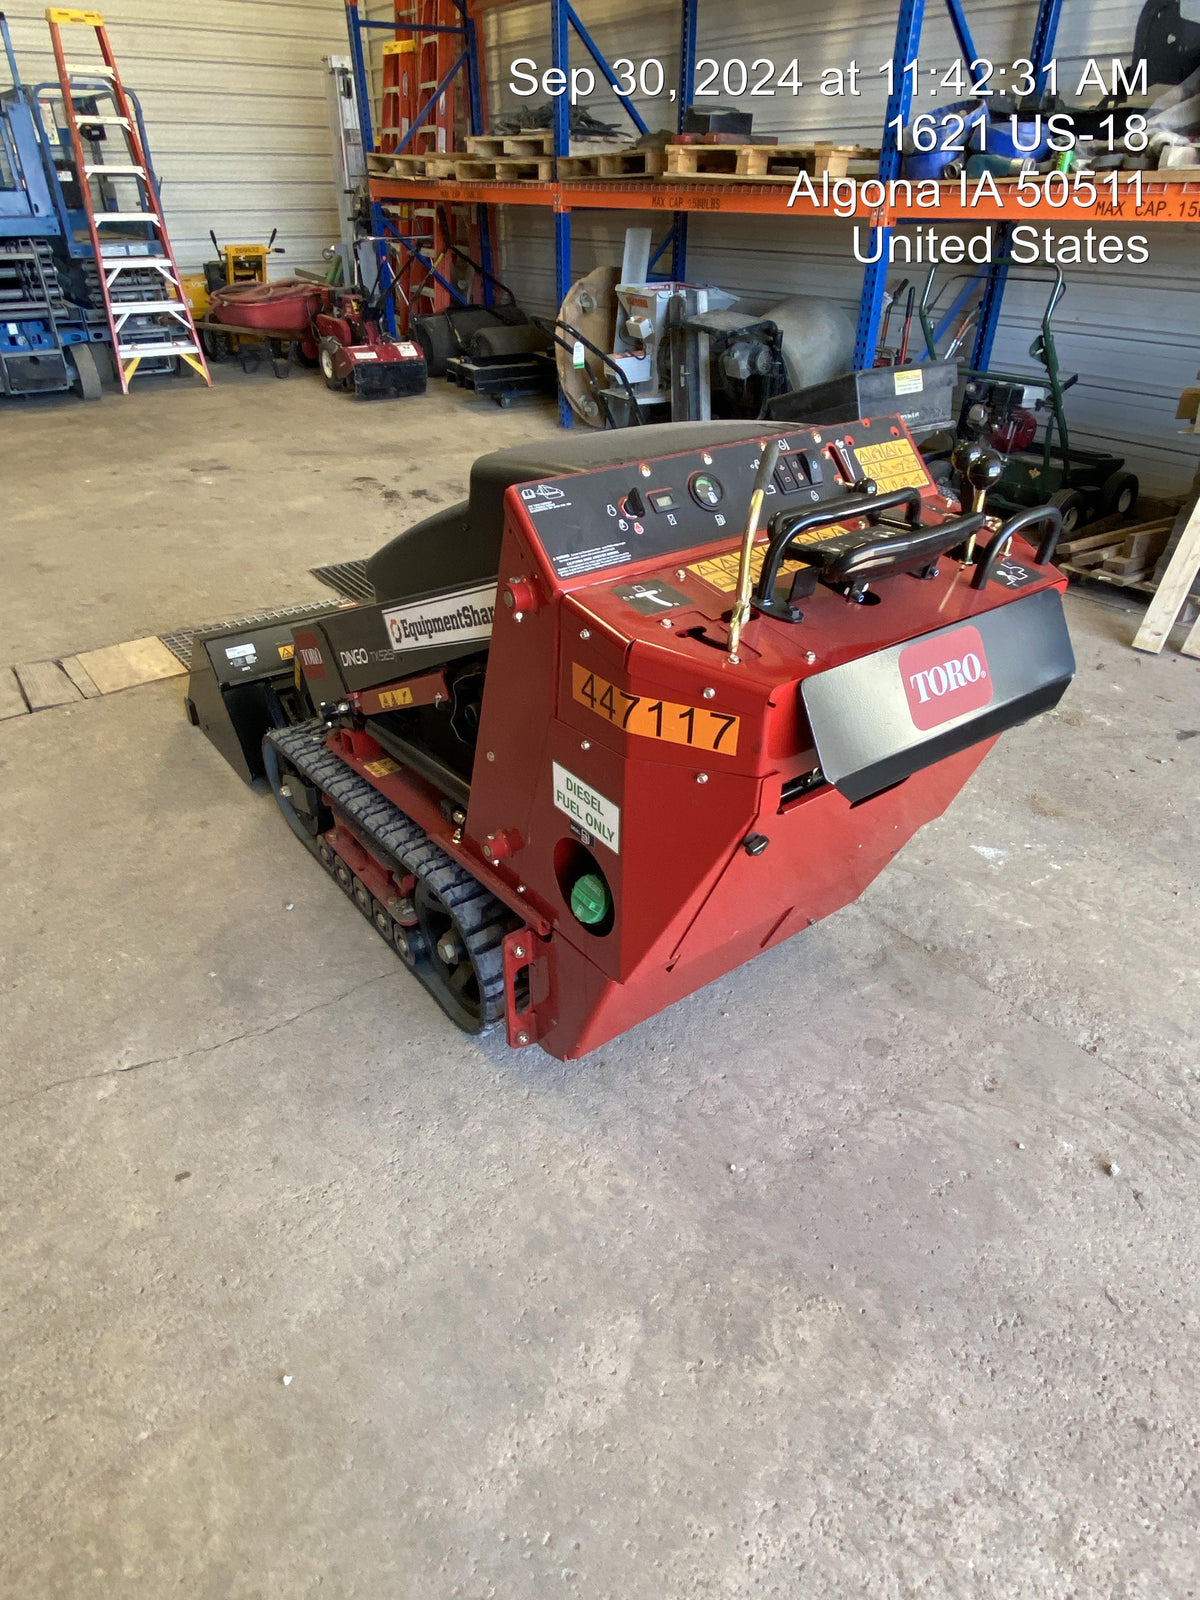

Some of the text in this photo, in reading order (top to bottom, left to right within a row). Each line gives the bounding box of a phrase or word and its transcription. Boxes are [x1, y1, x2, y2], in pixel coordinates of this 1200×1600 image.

[1094, 201, 1126, 217] MAX
[1179, 201, 1200, 217] 15
[400, 604, 495, 641] EquipmentShar
[300, 647, 323, 666] TORO
[581, 673, 737, 750] 447117
[565, 776, 605, 816] DIESEL
[556, 789, 615, 843] FUEL ONLY
